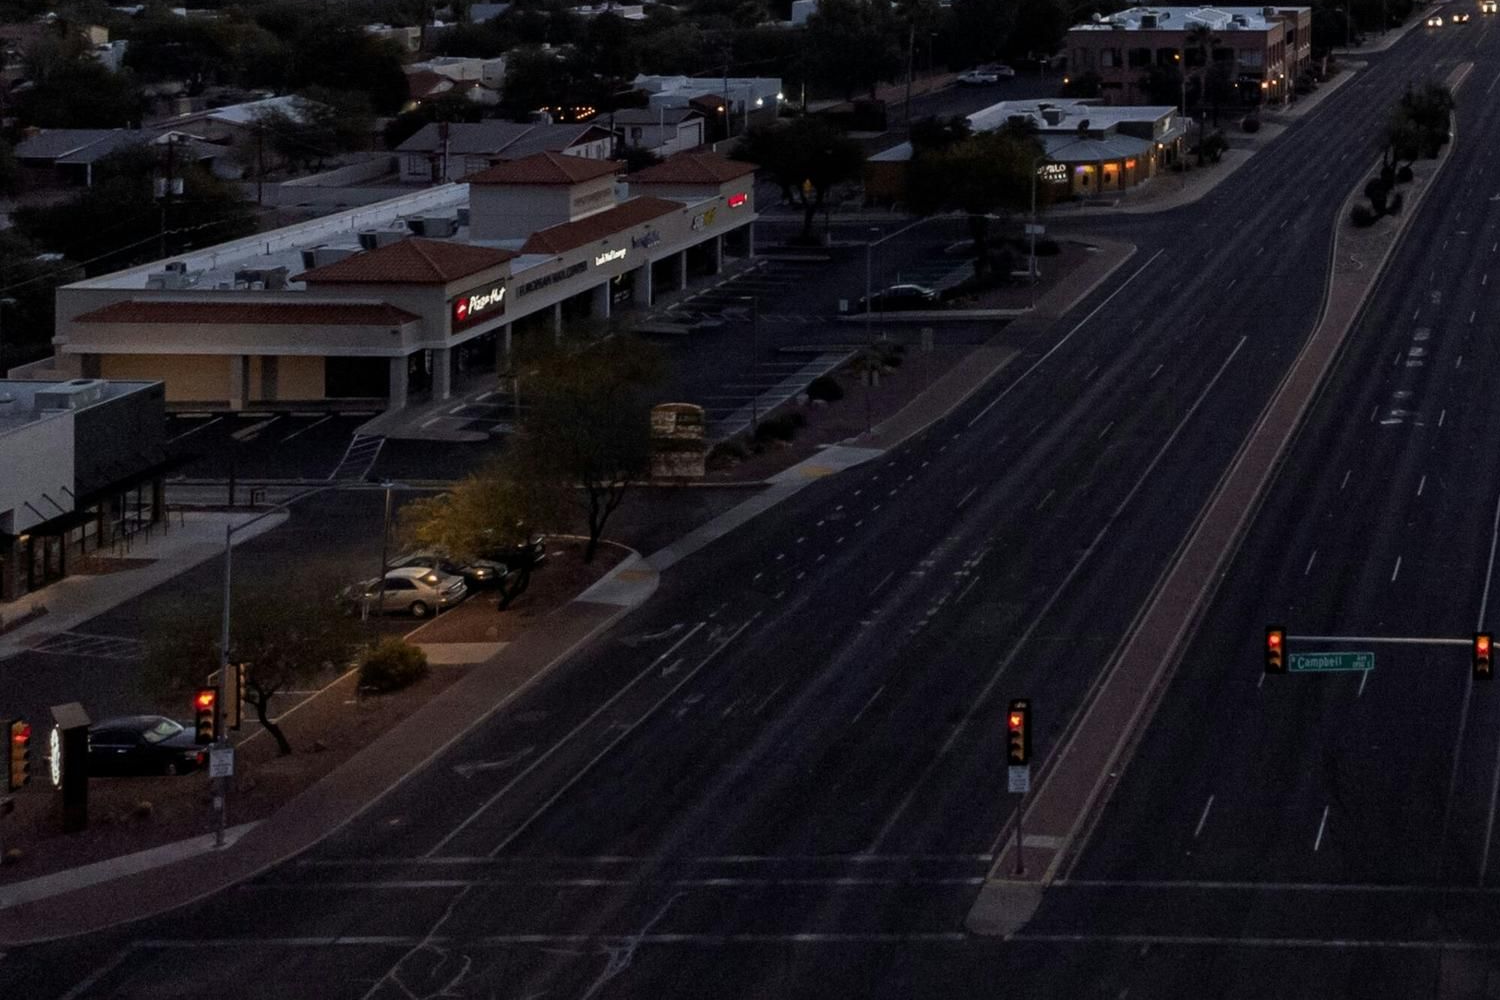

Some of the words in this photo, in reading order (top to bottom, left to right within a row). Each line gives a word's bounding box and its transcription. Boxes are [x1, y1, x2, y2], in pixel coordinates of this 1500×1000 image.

[468, 295, 490, 315] Pizza
[490, 287, 506, 304] Hut
[1297, 656, 1342, 669] Campbell
